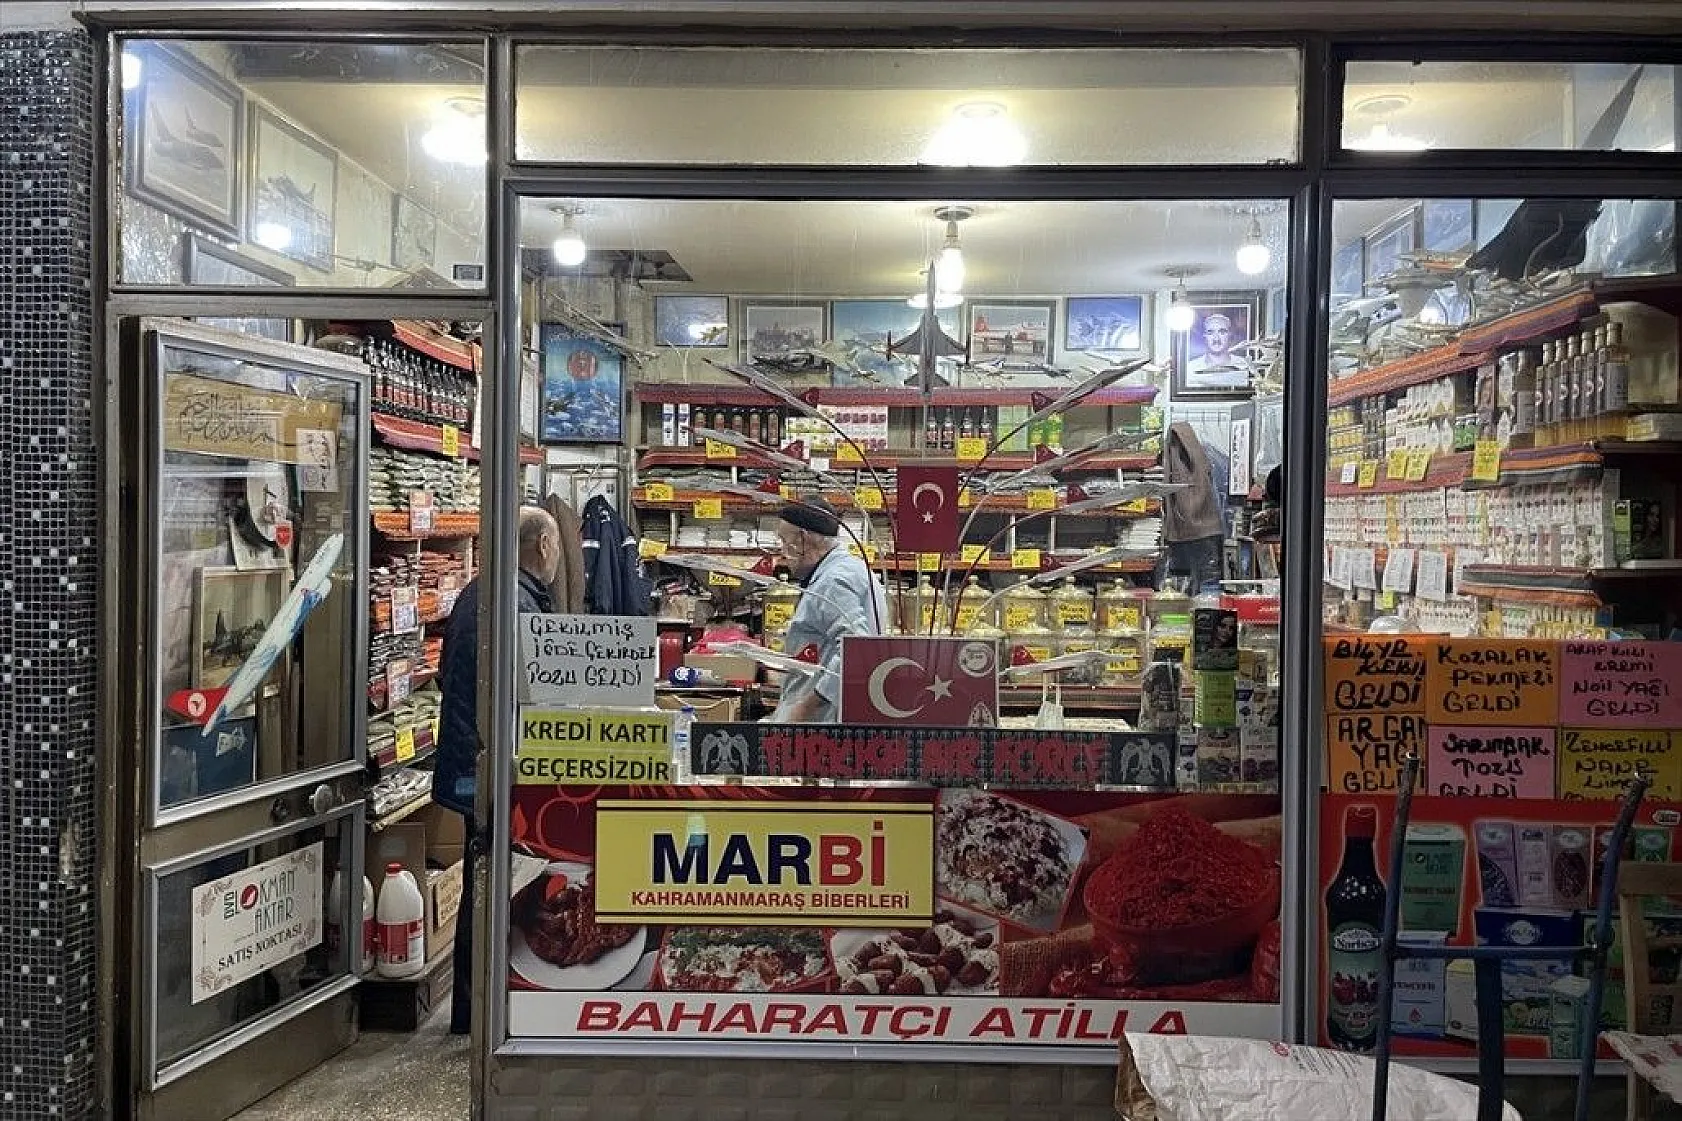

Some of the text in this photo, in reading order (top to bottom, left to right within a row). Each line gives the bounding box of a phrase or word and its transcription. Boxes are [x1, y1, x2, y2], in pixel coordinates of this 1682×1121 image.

[1437, 645, 1551, 665] KOZALAK
[584, 664, 642, 688] GELDİ
[1335, 677, 1421, 709] GELDİ
[1442, 690, 1520, 713] GELDİ
[1586, 698, 1660, 717] GELDİ
[523, 718, 668, 744] KREDİ KARTI
[519, 755, 670, 781] GEÇERSİZDİR
[652, 819, 886, 886] MARBİ
[631, 889, 911, 911] KAHRAMANMARAŞ BİBERLERİ
[576, 1001, 1188, 1039] BAHARATÇI ATİLLA
